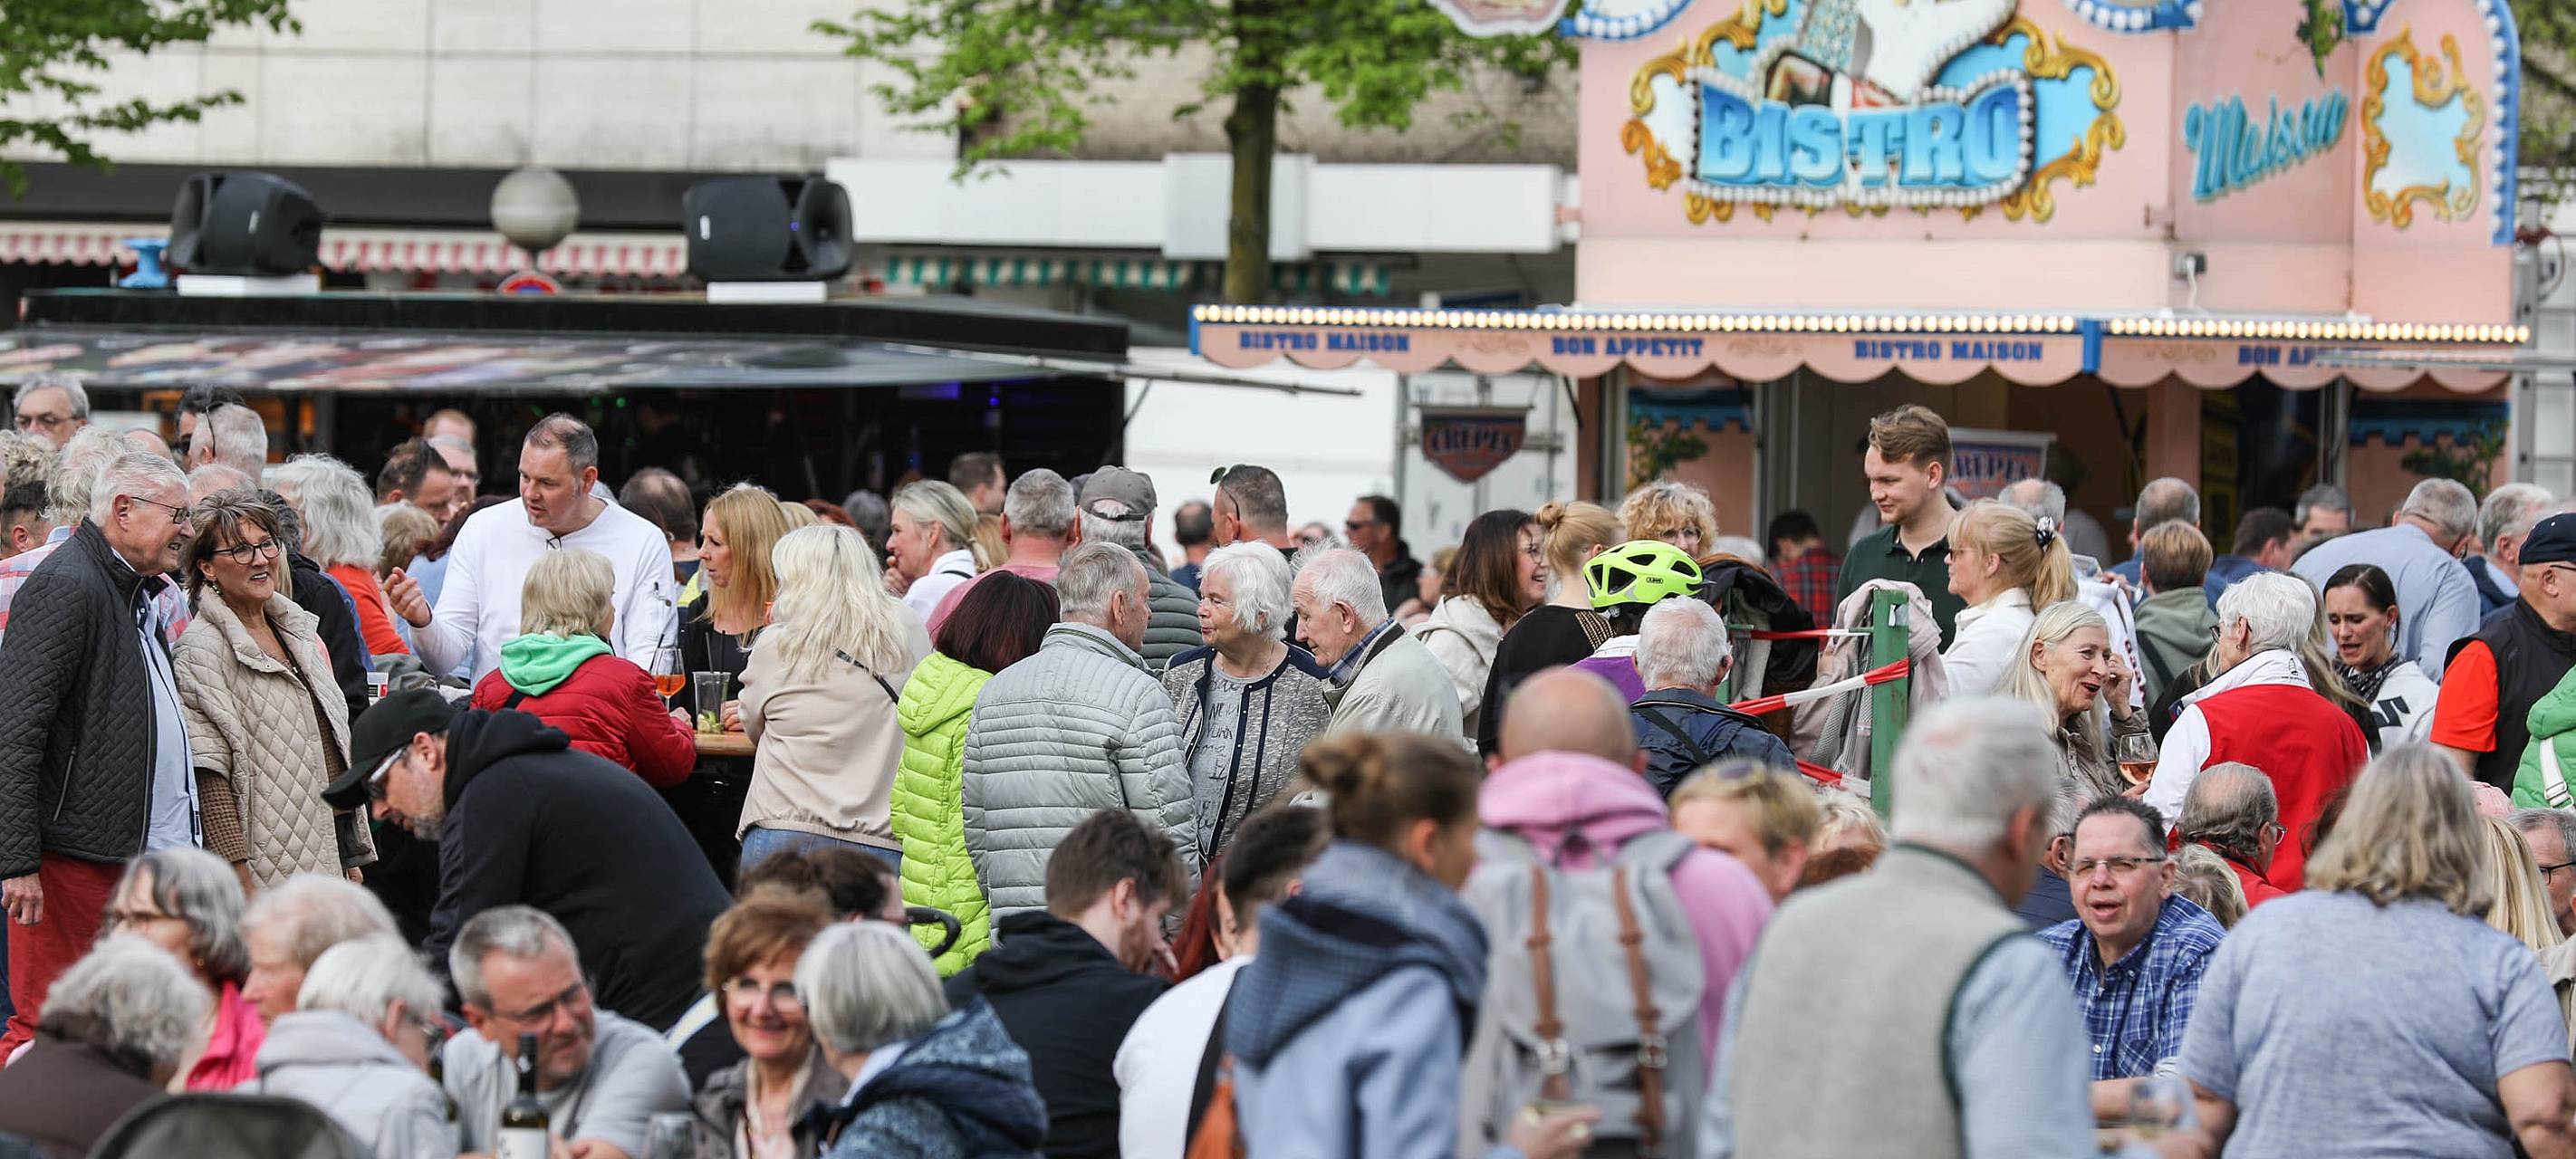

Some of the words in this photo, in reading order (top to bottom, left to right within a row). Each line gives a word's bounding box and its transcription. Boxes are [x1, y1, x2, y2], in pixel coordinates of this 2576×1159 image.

[1700, 81, 2021, 187] BISTRO
[2185, 88, 2350, 203] Maison
[1239, 331, 1318, 350] BISTRO
[1327, 332, 1410, 351] MAISON
[1552, 337, 1596, 356] BON
[1605, 338, 1704, 357] APPETIT
[1855, 340, 1941, 359] BISTRO
[1952, 341, 2043, 360] MAISON
[2238, 346, 2281, 365] BON
